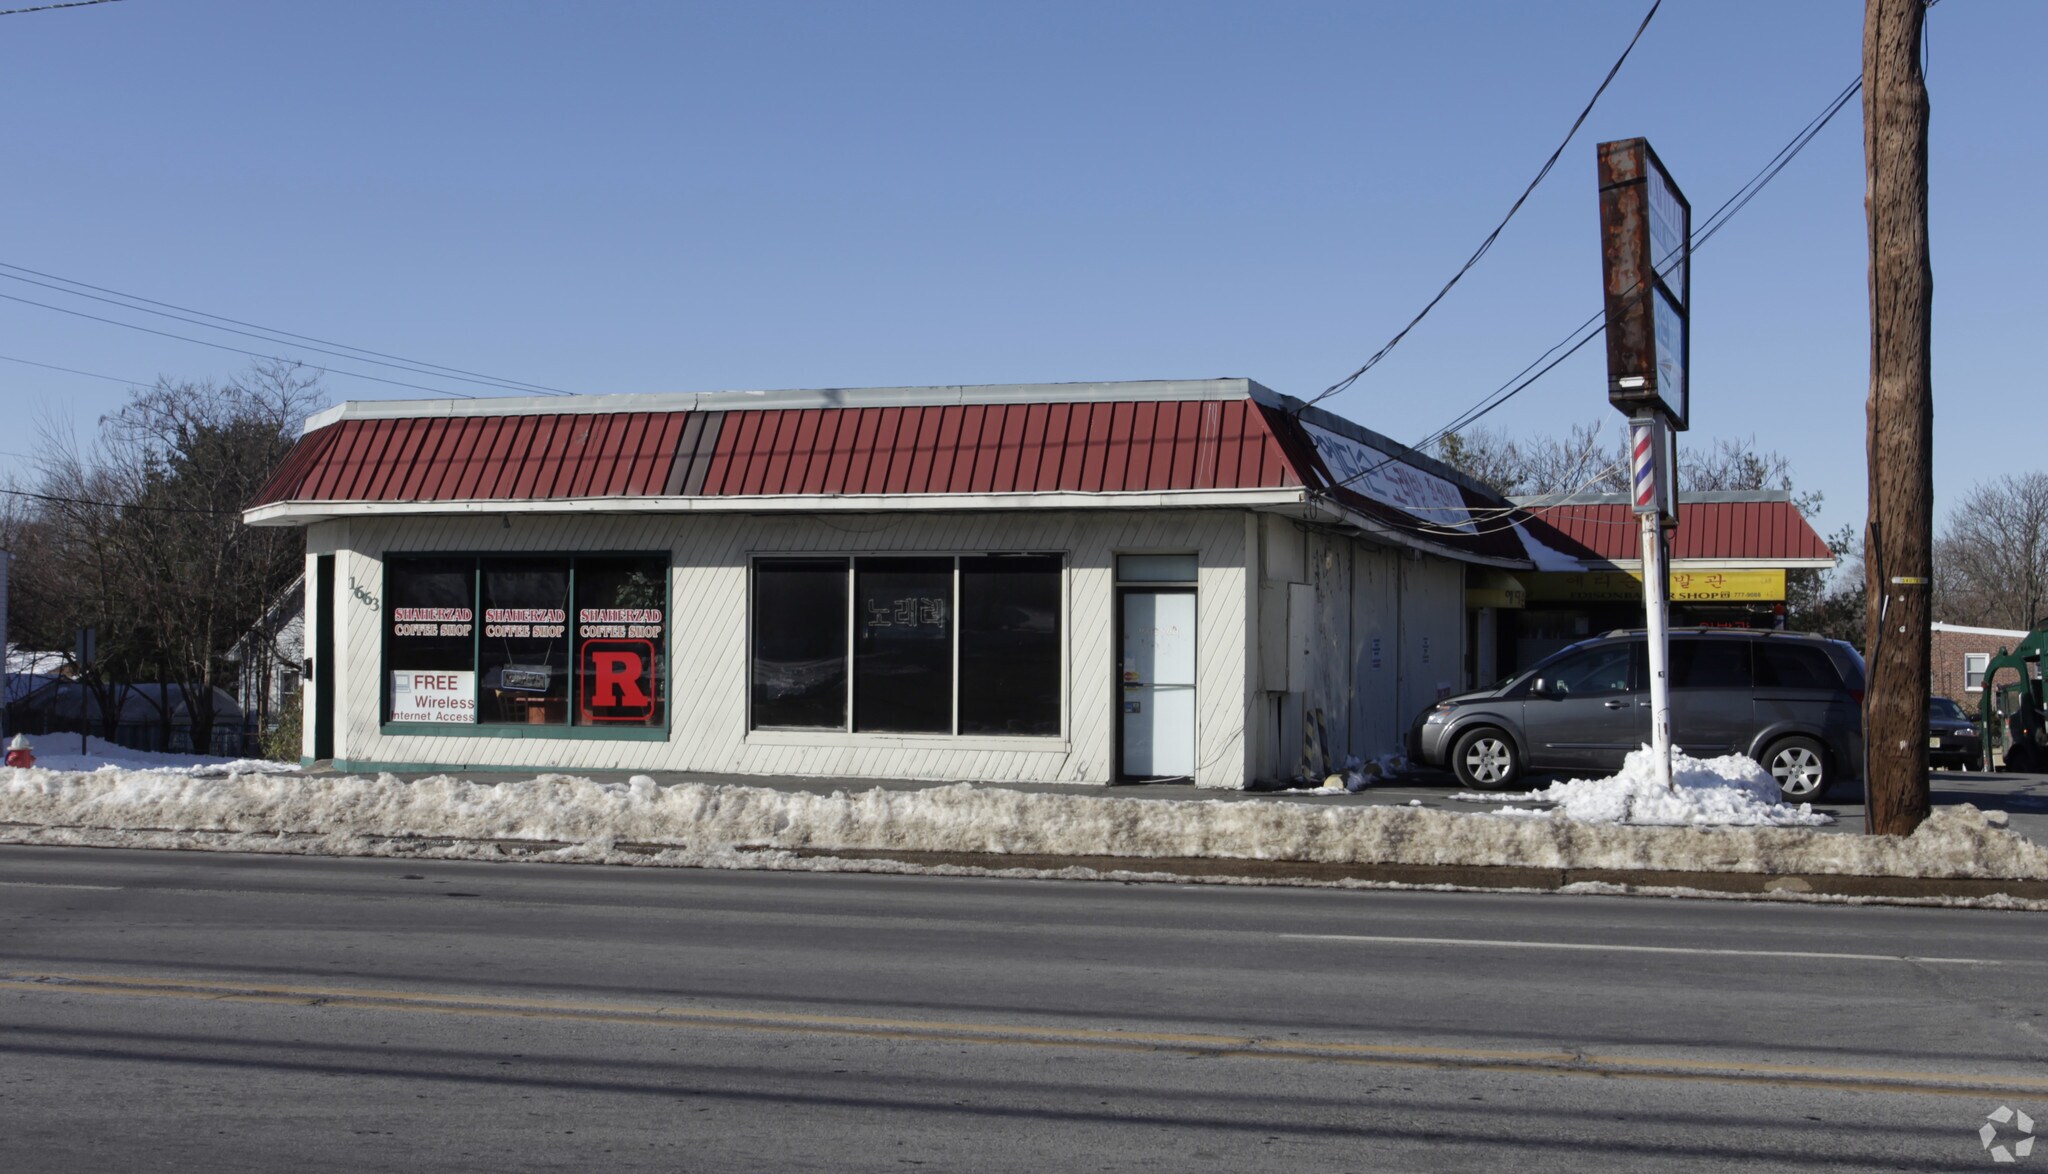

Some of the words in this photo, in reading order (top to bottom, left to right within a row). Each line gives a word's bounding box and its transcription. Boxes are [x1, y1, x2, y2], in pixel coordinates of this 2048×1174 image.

[348, 576, 380, 612] 1663
[1679, 591, 1719, 599] SHOP
[395, 607, 472, 622] SHAHERZAD
[486, 608, 566, 623] SHAHERZAD
[580, 608, 662, 623] SHAHERZAD
[395, 624, 438, 636] COFFEE
[440, 624, 472, 636] SHOP
[486, 625, 530, 637] COFFEE
[532, 625, 565, 637] SHOP
[580, 625, 626, 637] COFFEE
[628, 625, 661, 637] SHOP
[414, 675, 458, 690] FREE
[591, 651, 649, 707] R
[414, 695, 475, 709] Wireless
[391, 710, 431, 721] Internet
[435, 711, 474, 722] Access
